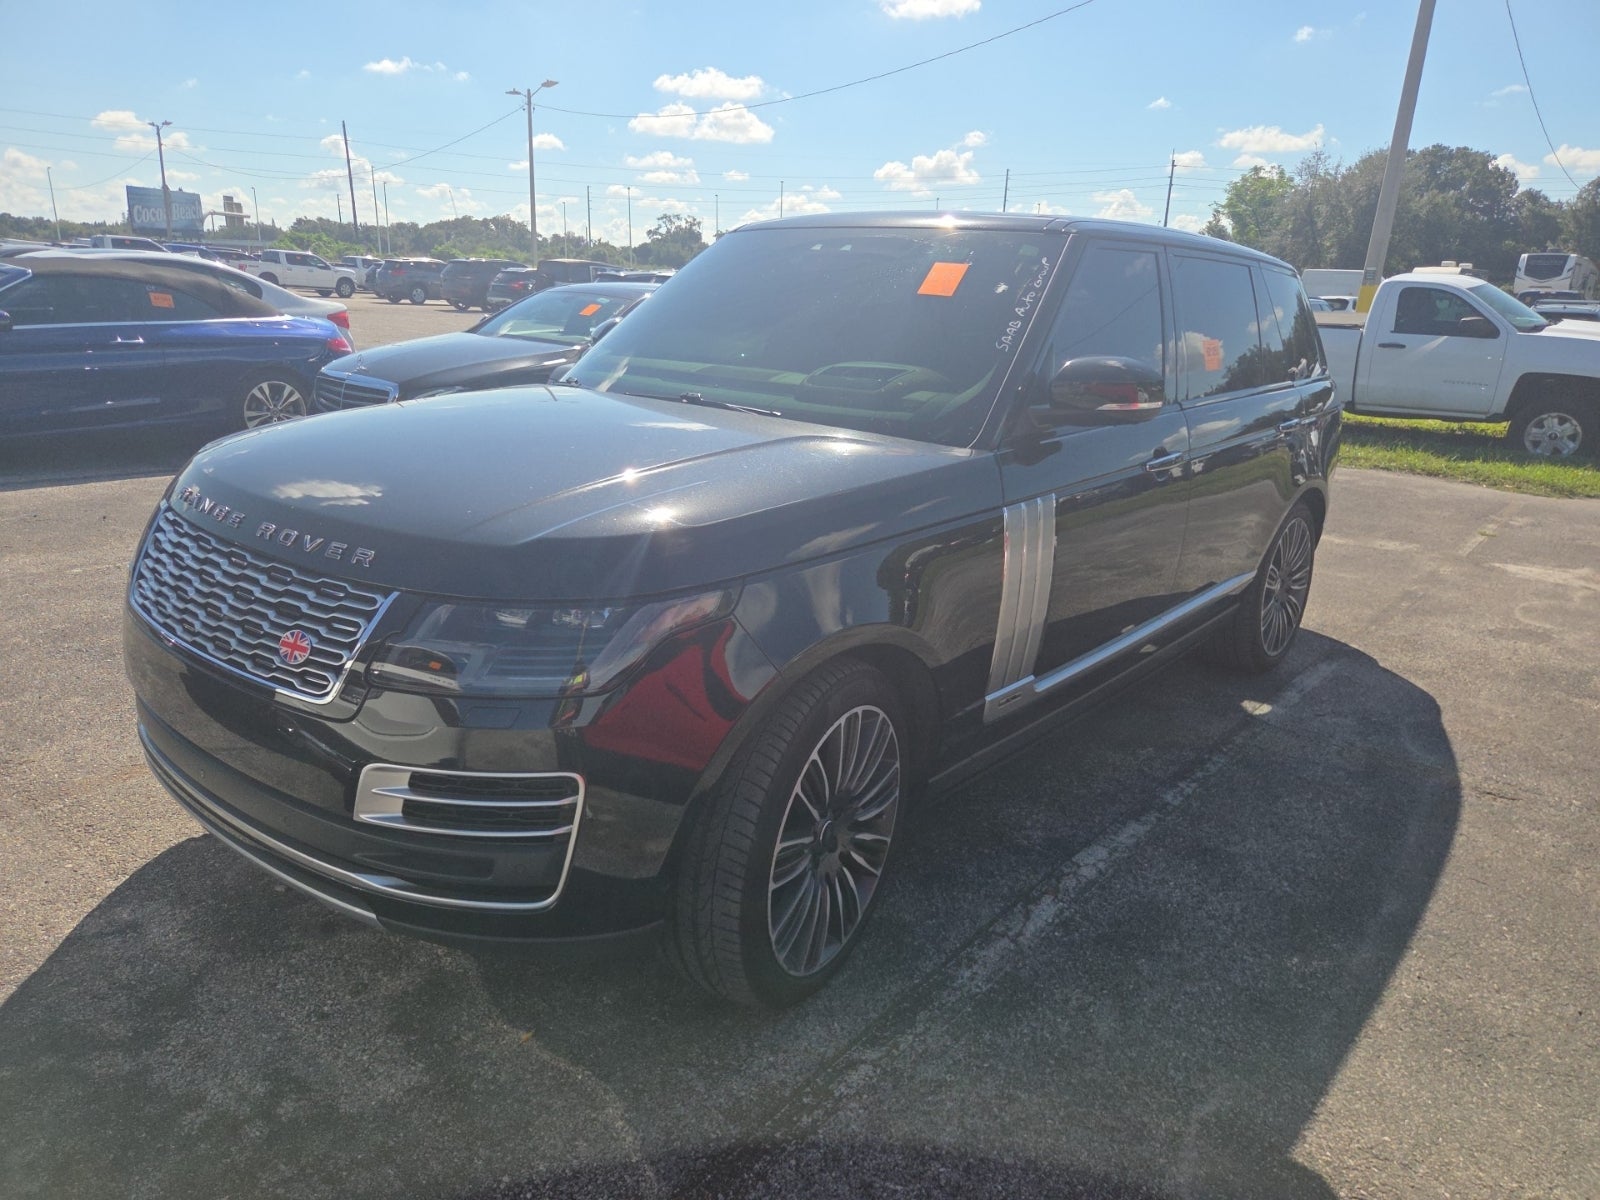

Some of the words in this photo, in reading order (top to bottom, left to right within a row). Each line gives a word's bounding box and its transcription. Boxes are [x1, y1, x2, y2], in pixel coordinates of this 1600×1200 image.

[133, 205, 166, 223] Coco
[172, 201, 203, 220] Beach
[995, 320, 1022, 352] SAAB
[1014, 291, 1036, 317] Auto
[179, 487, 246, 529] RANGE
[255, 521, 375, 568] ROVER
